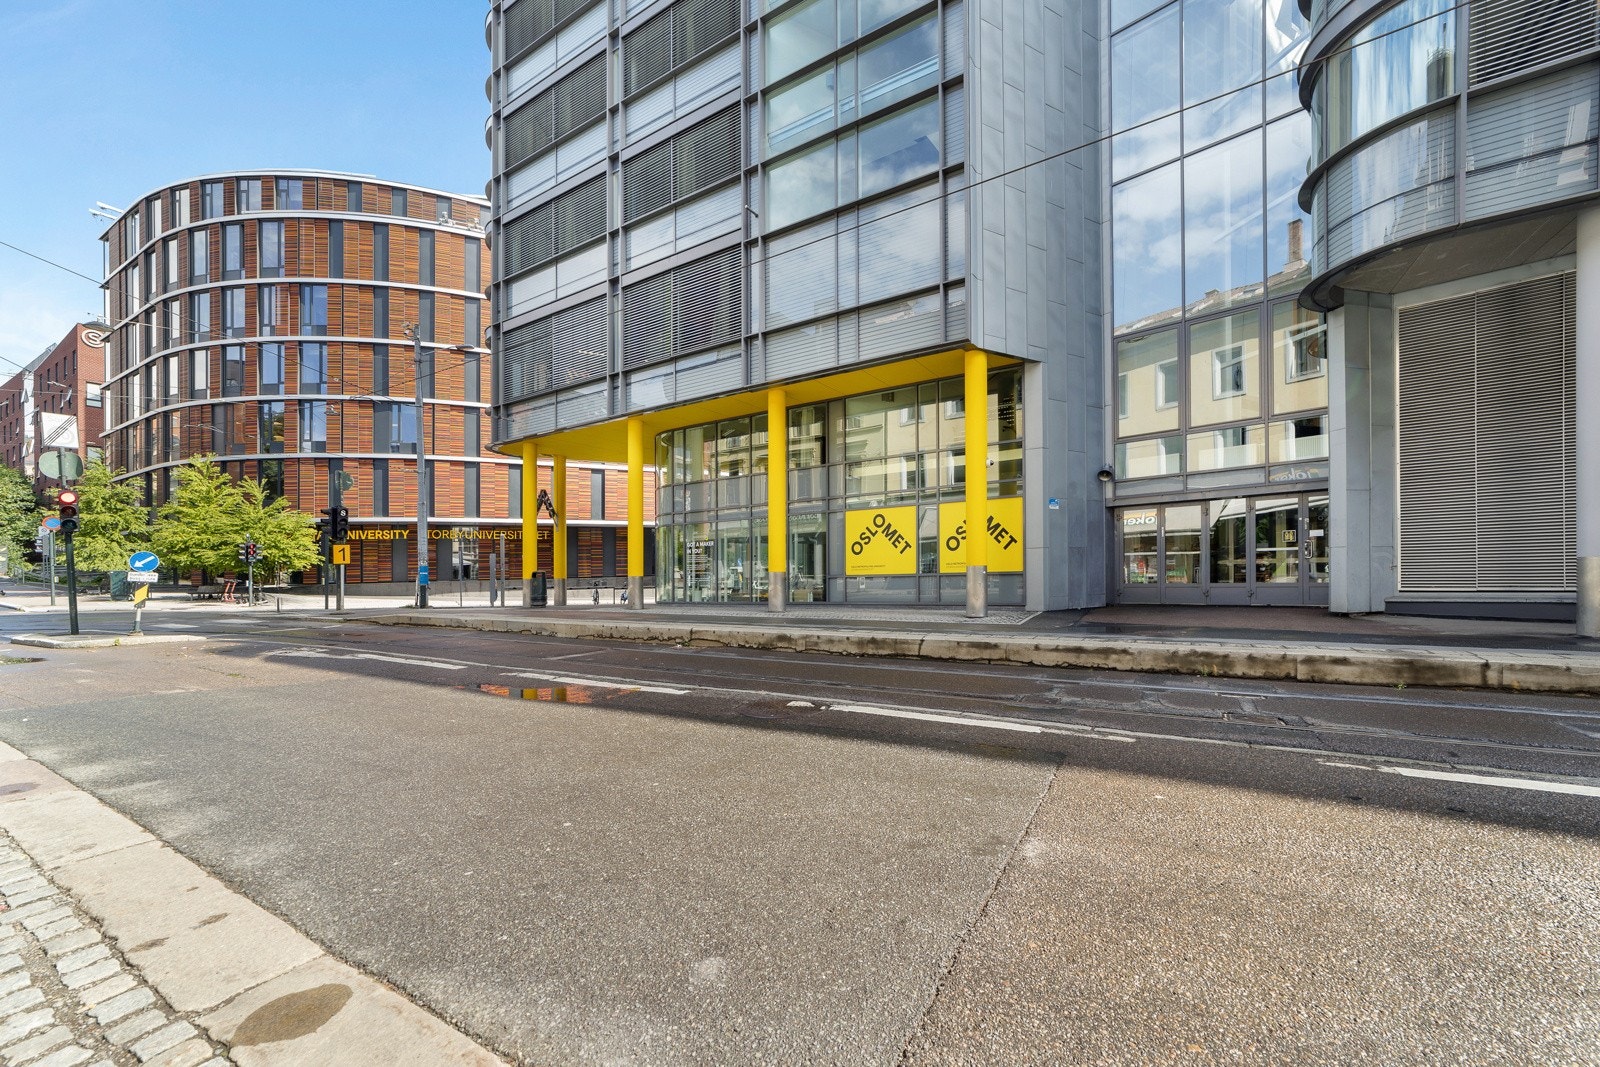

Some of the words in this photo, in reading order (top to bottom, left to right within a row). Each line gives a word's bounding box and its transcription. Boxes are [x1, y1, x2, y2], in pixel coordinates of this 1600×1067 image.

[346, 529, 410, 540] NIVERSITY
[946, 515, 1018, 552] OSMET
[338, 548, 346, 562] 1
